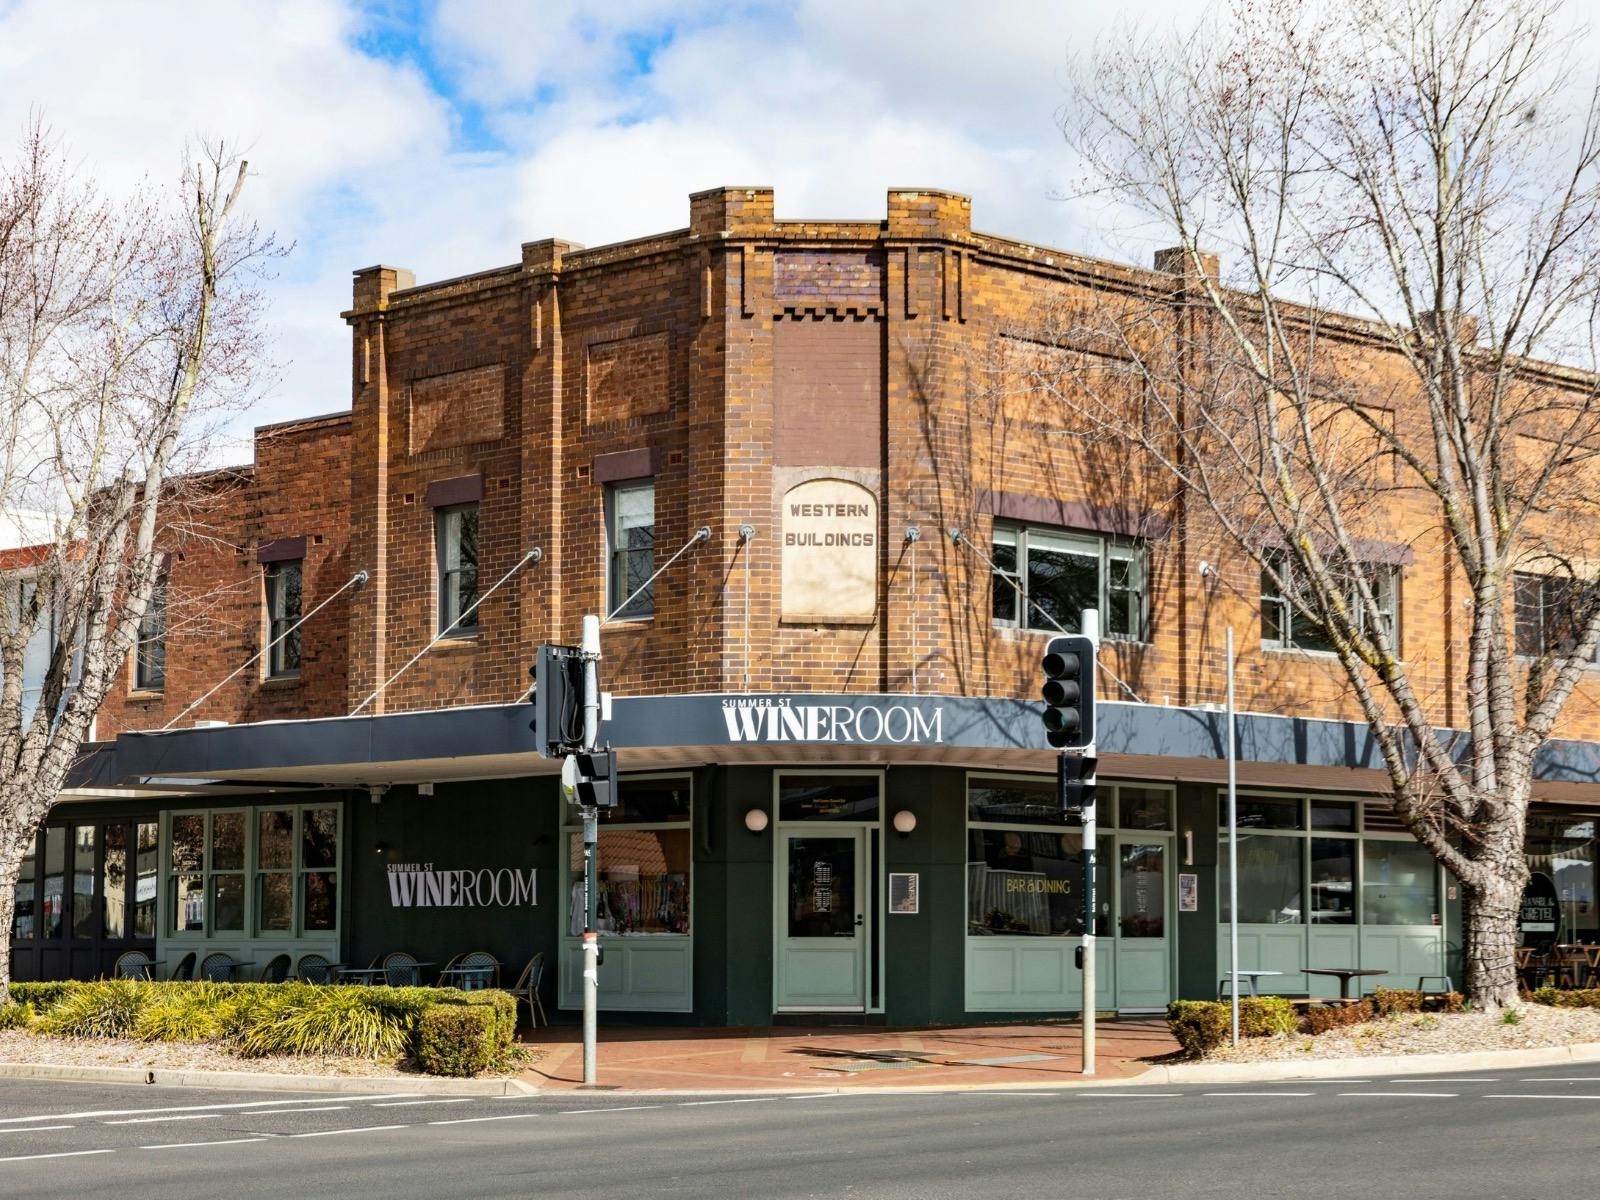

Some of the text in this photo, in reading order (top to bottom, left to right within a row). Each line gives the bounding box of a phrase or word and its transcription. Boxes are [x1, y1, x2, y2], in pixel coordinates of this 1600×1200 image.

[790, 504, 868, 517] WESTERN
[785, 533, 874, 546] BUILDINGS
[722, 699, 792, 709] SUMMER ST
[722, 706, 943, 743] WINEROOM
[387, 863, 434, 872] SUMMER ST
[387, 868, 538, 907] WINEROOM
[1007, 879, 1026, 892] BAR
[1037, 879, 1071, 894] DINING
